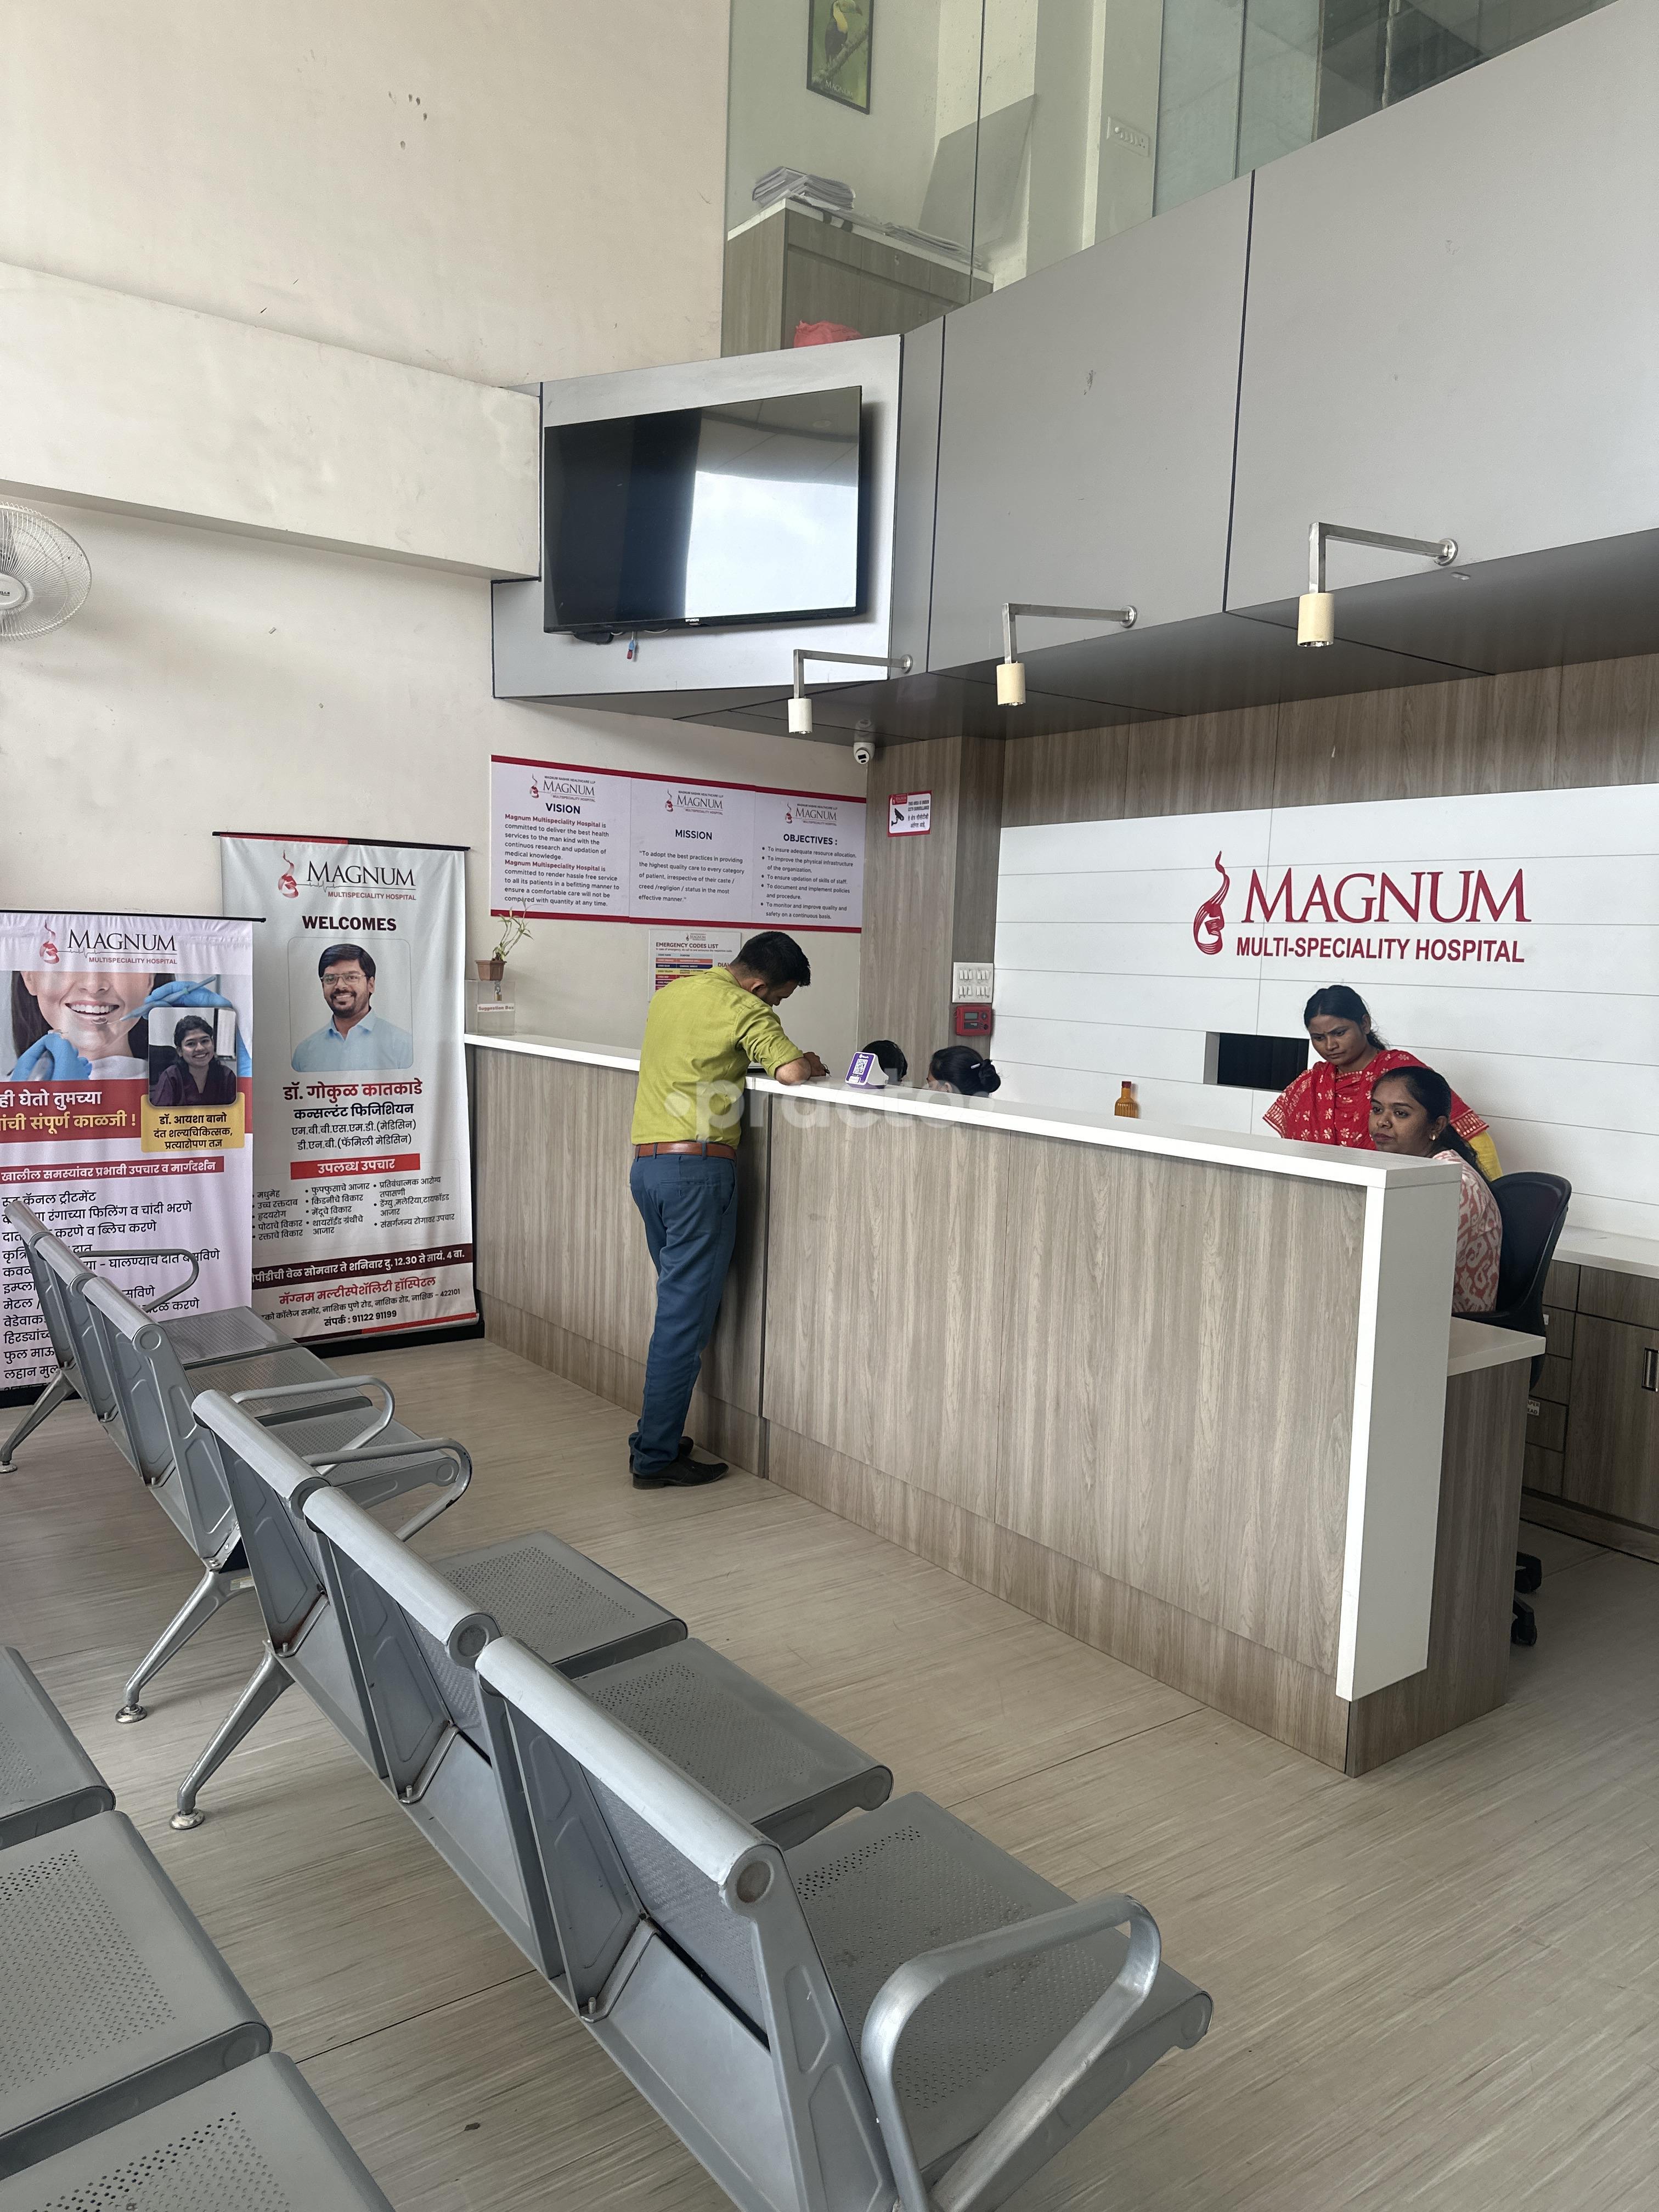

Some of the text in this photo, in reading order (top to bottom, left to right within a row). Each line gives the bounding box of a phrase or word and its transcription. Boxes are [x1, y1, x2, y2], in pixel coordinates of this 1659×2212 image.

[543, 780, 595, 795] MAGNUM
[546, 803, 580, 814] VISION
[676, 795, 723, 809] MAGNUM
[795, 808, 837, 820] MAGNUM
[533, 816, 575, 826] Multispeciality
[676, 830, 712, 840] MISSION
[783, 834, 833, 845] OBJECTIVES
[307, 861, 416, 886] MAGNUM
[1241, 866, 1532, 924] MAGNUM
[302, 916, 397, 931] WELCOMES
[67, 929, 177, 951] MAGNUM
[1237, 937, 1525, 963] MULTI-SPECIALITY HOSPITAL
[283, 1077, 423, 1102] डॉ. गोकुळ कातकाडे
[19, 1089, 50, 1106] घेतो
[53, 1092, 102, 1110] तुमच्या
[294, 1102, 414, 1119] कन्सल्टंट फिजिशियन
[30, 1110, 70, 1133] संपूर्ण
[73, 1110, 127, 1127] काळजी
[159, 1112, 227, 1125] डॉ. आयशा बानो
[154, 1126, 232, 1138] दंत शल्यचिकित्सक,
[165, 1139, 207, 1149] प्रत्यारोपण
[375, 1133, 411, 1145] मेडिसिन)
[1, 1160, 216, 1181] खालील समस्यांवर प्रभावी उपचार व मार्गदर्शन
[318, 1159, 395, 1173] उपलब्ध उपचार
[257, 1189, 280, 1200] मधुमेह
[311, 1183, 347, 1196] फुफ्फुसाचे
[379, 1188, 405, 1198] तपासणी
[22, 1190, 97, 1205] कॅनल ट्रीटमेंट
[272, 1199, 298, 1207] रक्तदाब
[311, 1194, 363, 1205] किडनीचे विकार
[48, 1207, 86, 1221] रंगाच्या
[88, 1205, 128, 1218] फिलिंग
[130, 1206, 139, 1215] व
[141, 1201, 164, 1215] चांदी
[167, 1200, 193, 1213] भरणे
[312, 1206, 352, 1217] मेंदूचे विकार
[258, 1220, 303, 1231] पोटाचे विकार
[380, 1214, 455, 1228] संसर्गजन्य रोगावर उपचार
[54, 1224, 84, 1238] करणे
[86, 1226, 95, 1235] व
[98, 1222, 126, 1235] ब्लिच
[128, 1220, 157, 1233] करणे
[258, 1229, 303, 1240] रक्ताचे विकार
[313, 1227, 335, 1235] आजार
[161, 1254, 180, 1264] दात
[286, 1268, 303, 1278] वेळ
[304, 1265, 338, 1276] सोमवार
[340, 1261, 347, 1272] ते
[349, 1259, 383, 1271] शनिवार
[384, 1259, 393, 1269] दु.
[394, 1256, 417, 1266] 12.30
[419, 1253, 426, 1263] ते
[427, 1250, 445, 1262] सायं.
[453, 1250, 465, 1258] वा.
[3, 1282, 36, 1294] इम्प्ला
[279, 1276, 436, 1305] मॅग्नम मल्टीस्पेशॅलिटी हॉस्पिटल
[3, 1299, 33, 1310] मेटल
[172, 1297, 200, 1310] करणे
[276, 1310, 300, 1319] कॉलेज
[301, 1306, 321, 1316] समोर,
[322, 1303, 347, 1312] नाशिक
[347, 1300, 359, 1312] पुणे
[360, 1300, 373, 1308] रोड,
[375, 1297, 398, 1306] नाशिक
[399, 1295, 410, 1303] रोड,
[411, 1290, 433, 1301] नाशिक
[440, 1289, 460, 1297] 422101
[324, 1314, 346, 1326] संपर्क
[352, 1313, 374, 1323] 91122
[376, 1310, 397, 1319] 91199
[3, 1350, 29, 1364] फुल
[4, 1367, 37, 1379] लहान
